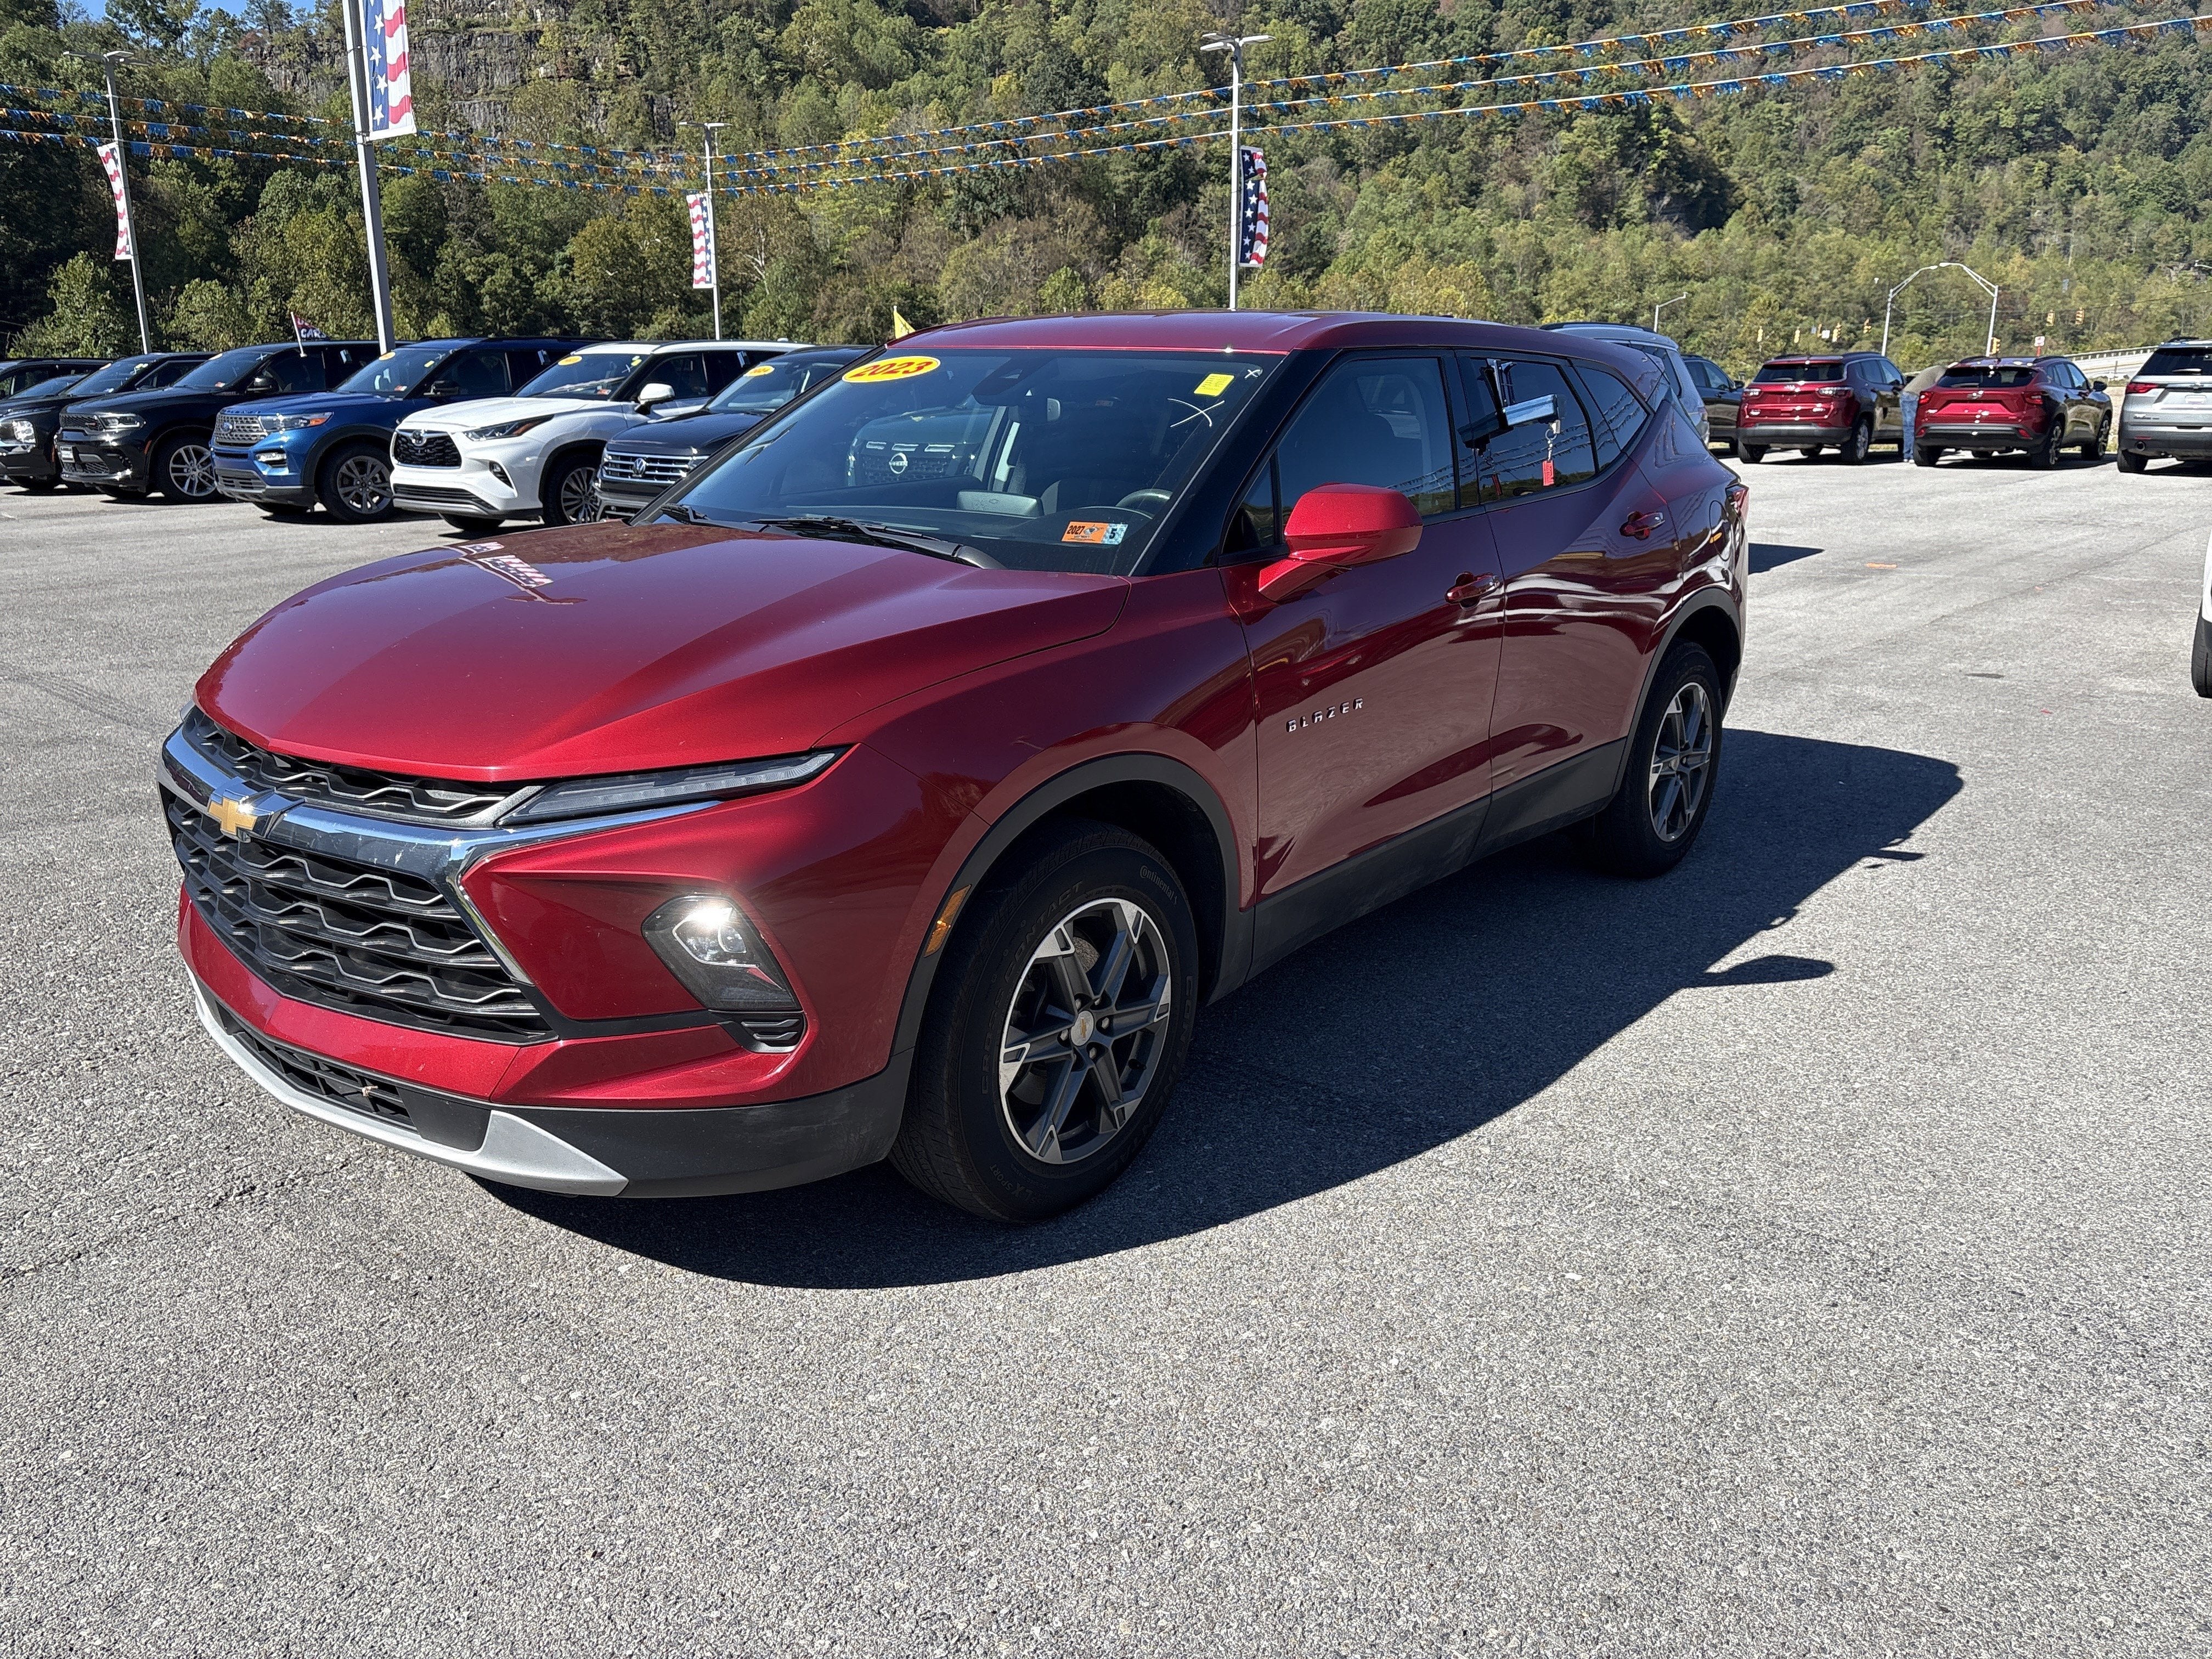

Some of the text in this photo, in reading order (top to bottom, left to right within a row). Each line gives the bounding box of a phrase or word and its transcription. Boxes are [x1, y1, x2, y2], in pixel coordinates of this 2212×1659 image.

[848, 362, 933, 378] 2023
[1066, 525, 1117, 539] 2027 5
[1286, 698, 1363, 732] BLAZER
[1140, 865, 1174, 900] Continental
